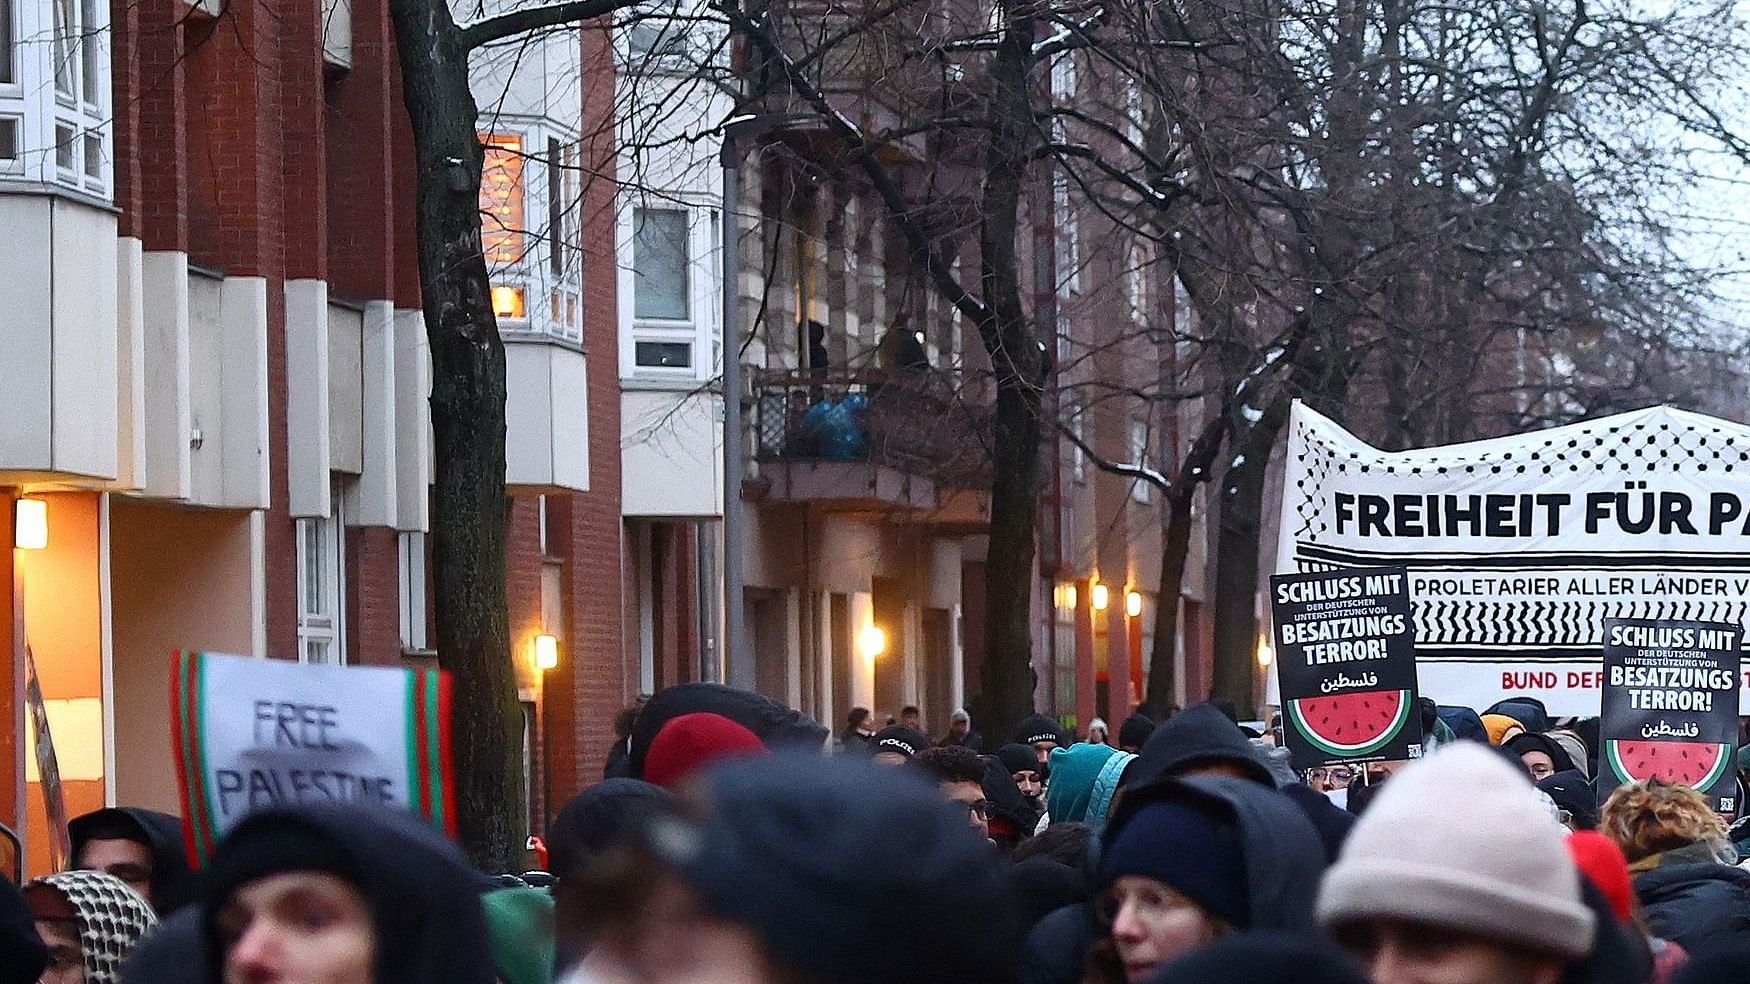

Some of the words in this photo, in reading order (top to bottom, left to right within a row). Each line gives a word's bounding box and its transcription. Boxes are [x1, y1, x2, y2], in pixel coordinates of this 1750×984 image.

[1334, 491, 1571, 538] FREIHEIT
[1585, 480, 1699, 535] FÜR
[1277, 577, 1361, 604] SCHLUSS
[1365, 574, 1402, 596] MIT
[1414, 577, 1560, 596] PROLETARIER
[1566, 577, 1634, 595] ALLER
[1641, 573, 1728, 596] LÄNDER
[1294, 607, 1367, 621] UNTERSTÜTZUNG
[1369, 606, 1388, 615] VON
[1306, 603, 1324, 612] DER
[1325, 598, 1376, 610] DEUTSCHEN
[1281, 614, 1406, 645] BESATZUNGS
[1611, 626, 1695, 648] SCHLUSS
[1698, 629, 1736, 651] MIT
[1302, 638, 1388, 666] TERROR!
[1624, 657, 1698, 667] UNTERSTÜTZUNG
[1698, 660, 1718, 668] VON
[1637, 649, 1655, 657] DER
[1656, 649, 1707, 659] DEUTSCHEN
[1320, 671, 1378, 693] فلسطين
[1502, 671, 1557, 690] BUND
[1610, 665, 1733, 690] BESATZUNGS
[1628, 689, 1712, 712] TERROR!
[253, 700, 338, 751] FREE
[1641, 719, 1699, 738] فلسطين
